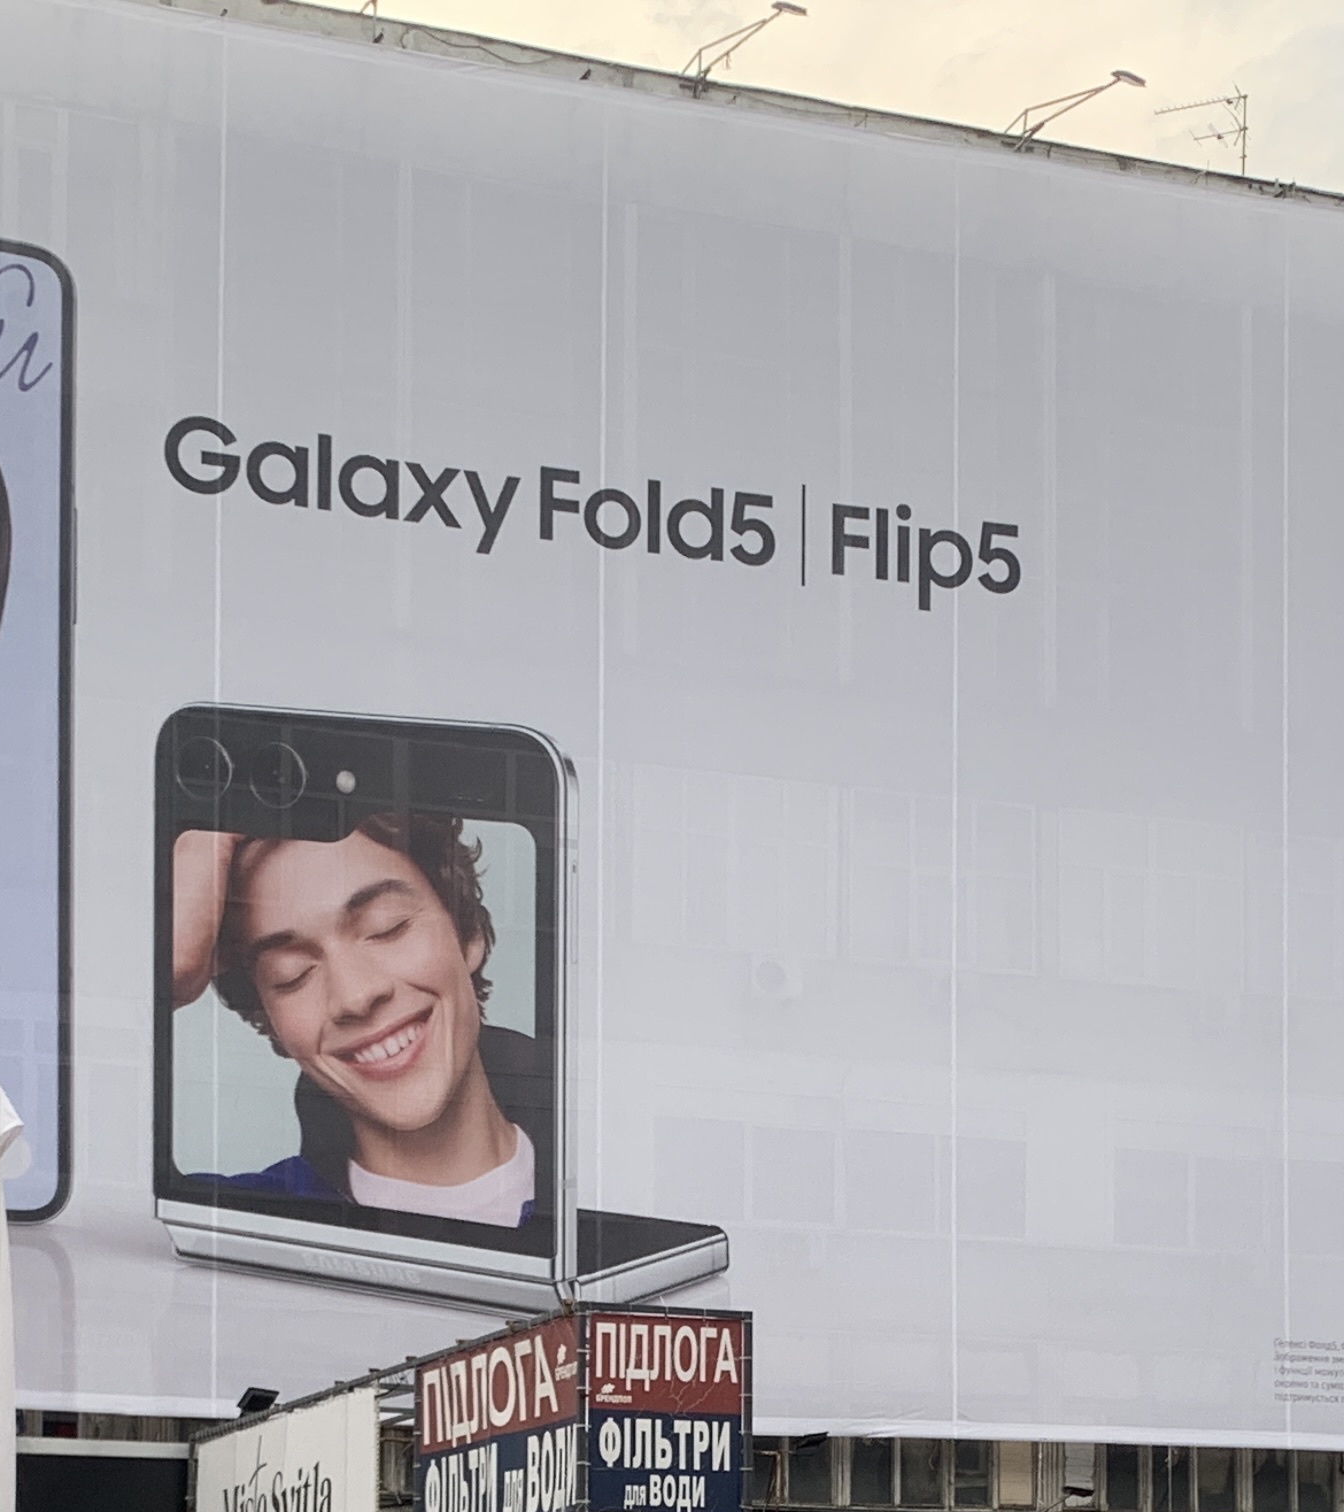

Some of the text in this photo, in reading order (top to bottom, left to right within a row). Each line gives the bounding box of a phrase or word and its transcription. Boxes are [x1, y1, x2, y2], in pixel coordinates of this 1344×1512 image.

[163, 414, 1022, 612] Galaxy Fold5 Flip5
[303, 1252, 422, 1285] SAMSUNG
[595, 1322, 739, 1391] ПІДЛОГА
[423, 1334, 559, 1448] ПІДЛОГА
[598, 1417, 731, 1472] ФІЛЬТРИ
[623, 1474, 706, 1512] для ВОДИ
